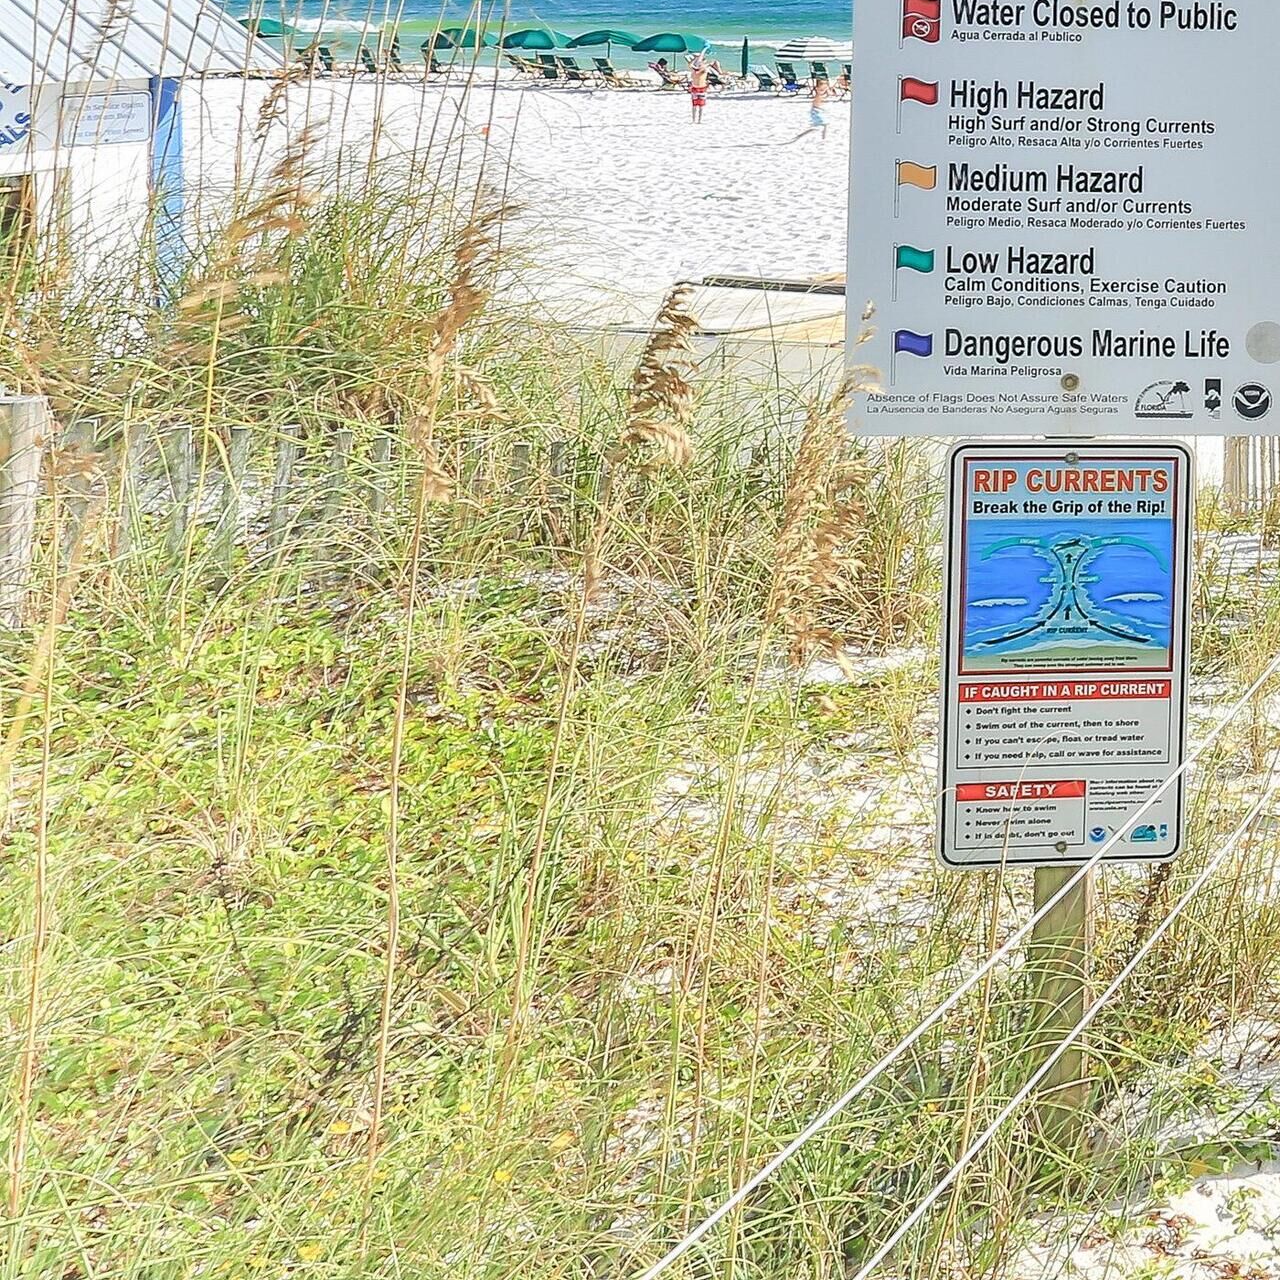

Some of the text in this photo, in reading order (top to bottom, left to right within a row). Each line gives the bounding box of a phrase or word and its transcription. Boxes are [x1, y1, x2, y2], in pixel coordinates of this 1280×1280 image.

[1034, 0, 1119, 27] Closed
[1127, 2, 1150, 28] to
[1161, 2, 1236, 30] Public
[952, 30, 1081, 42] Agua Cerrada al Publico
[951, 80, 1103, 115] High Hazard
[949, 115, 1214, 136] High Surf and/or Strong Currents
[949, 135, 1203, 149] Peligro Alto, Resaca Alta y/o Corrientes Fuertes
[949, 163, 1142, 193] Medium Hazard
[947, 197, 1191, 213] Moderate Surf and/or Currents
[947, 217, 1245, 230] Peligro Medio, Resaca Moderado y/o Corrientes Fuertes
[947, 246, 1093, 274] Low Hazard
[945, 277, 1225, 294] Calm Conditions, Exercise Caution
[945, 295, 1214, 309] Peligro Bajo, Condiciones Calmas, Tenga Cuidado
[946, 329, 1229, 364] Dangerous Marine Life
[944, 365, 1062, 379] Vida Marina Peligrosa
[867, 393, 1128, 404] Absence of Flags Does Not Assure Safe Waters
[881, 405, 925, 414] Ausencia
[1006, 406, 1044, 415] Asegura
[1047, 406, 1076, 415] Aguas
[1080, 405, 1118, 415] Seguras
[1141, 403, 1167, 411] FLORIDA
[974, 469, 1168, 493] RIP CURRENTS
[974, 501, 1164, 516] Break the Grip of the Rip!
[965, 683, 1165, 699] IF CAUGHT IN A RIP CURRENT
[1001, 707, 1020, 715] fight
[975, 819, 1000, 827] Never
[984, 832, 992, 840] in
